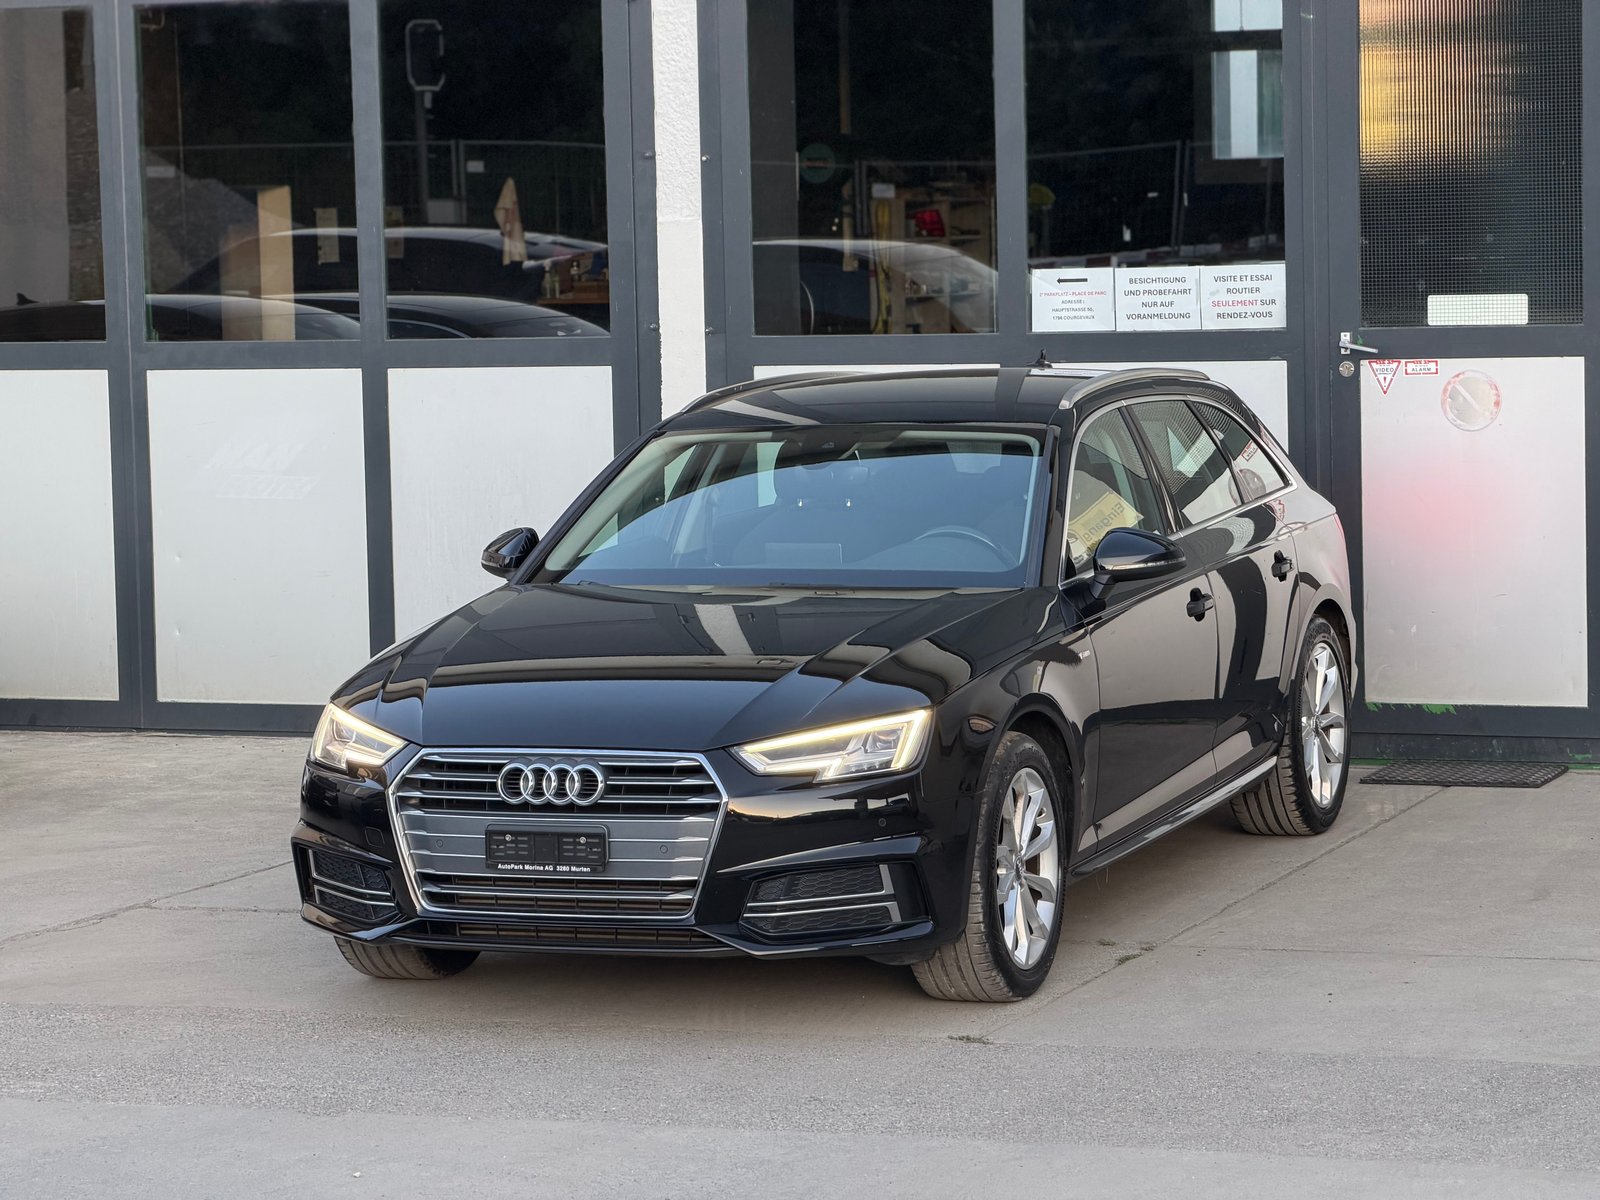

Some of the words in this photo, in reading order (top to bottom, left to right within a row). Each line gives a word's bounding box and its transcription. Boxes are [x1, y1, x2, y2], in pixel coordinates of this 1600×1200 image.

[1128, 276, 1187, 285] BESICHTIGUNG
[1213, 275, 1238, 283] VISITE
[1250, 274, 1273, 282] ESSAI
[1124, 289, 1140, 297] UND
[1142, 288, 1192, 297] PROBEFAHRT
[1226, 287, 1261, 295] ROUTIER
[1141, 301, 1158, 309] NUR
[1159, 300, 1175, 308] AUF
[1211, 299, 1259, 308] SEULEMENT
[1260, 298, 1277, 306] SUR
[1126, 312, 1191, 320] VORANMELDUNG
[1216, 311, 1273, 320] RENDEZ-VOUS
[570, 865, 591, 873] Murten
